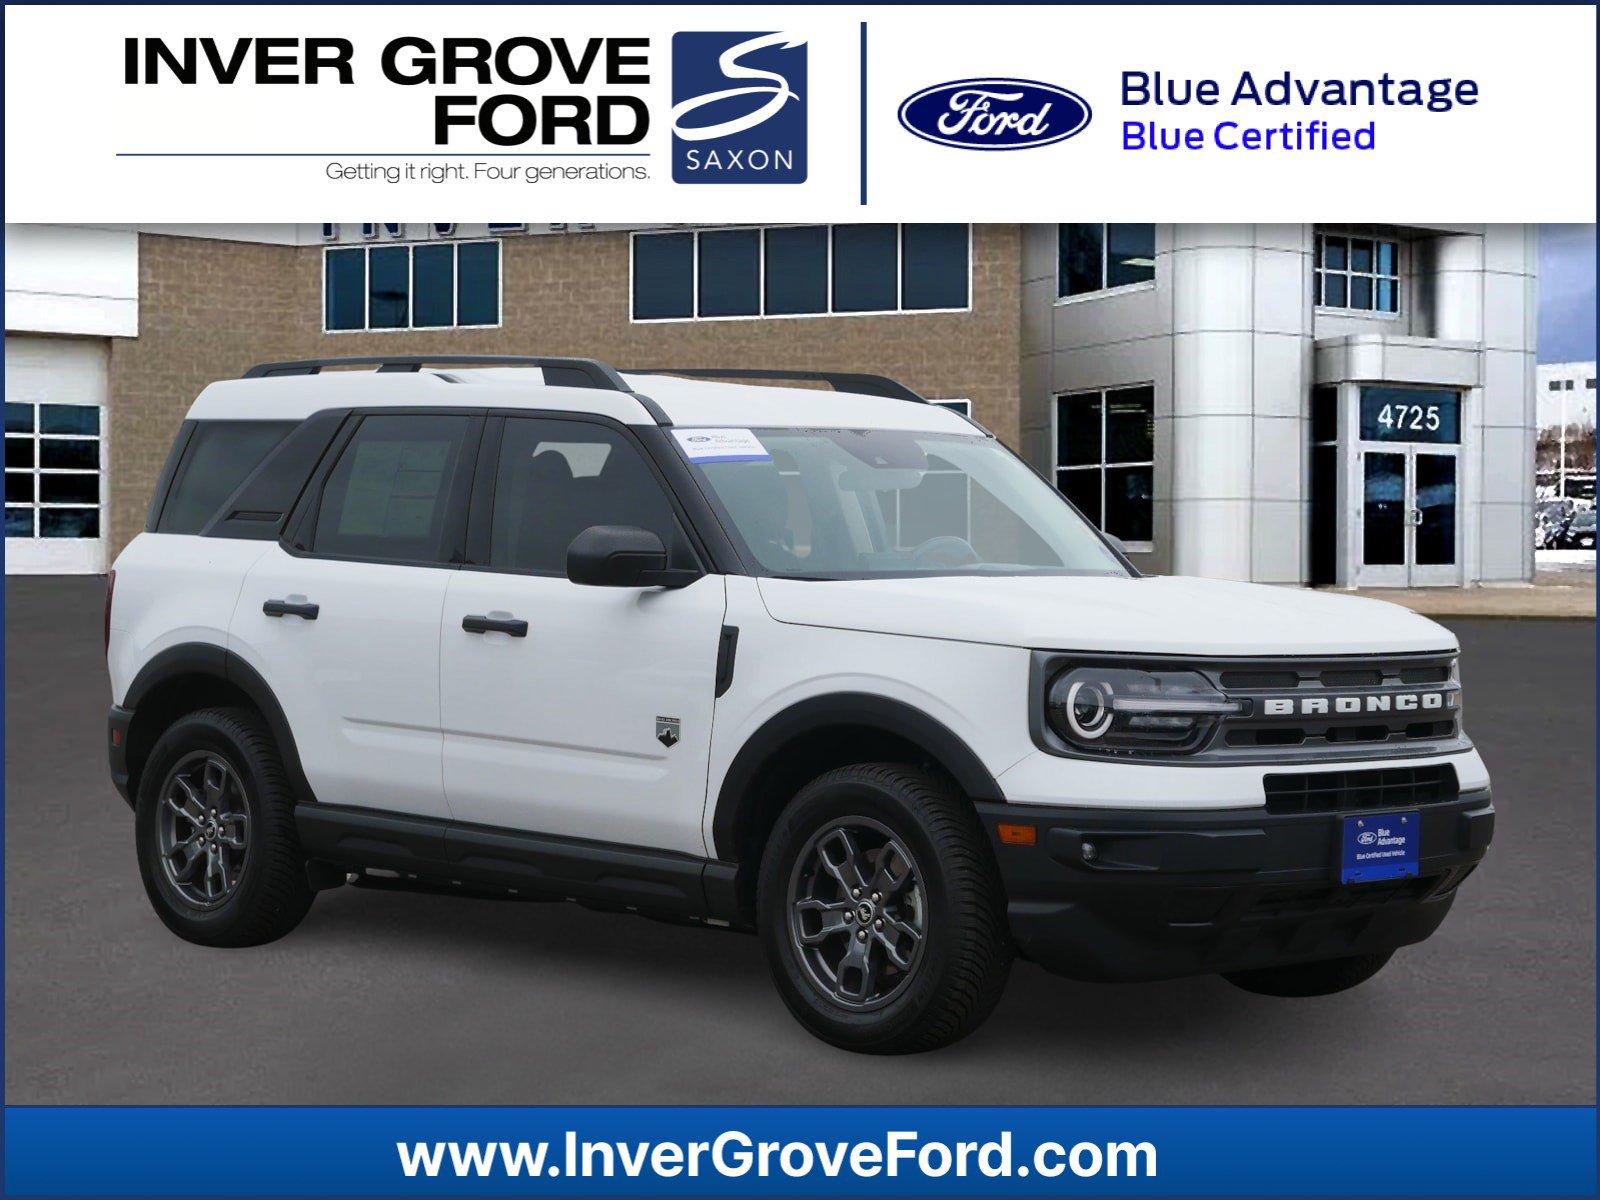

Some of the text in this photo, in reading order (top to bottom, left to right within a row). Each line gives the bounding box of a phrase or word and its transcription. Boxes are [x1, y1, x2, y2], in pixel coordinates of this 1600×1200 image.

[1377, 404, 1440, 431] 4725
[1264, 693, 1442, 715] BRONCO
[1378, 828, 1390, 837] Blue
[1377, 837, 1406, 846] Advantage
